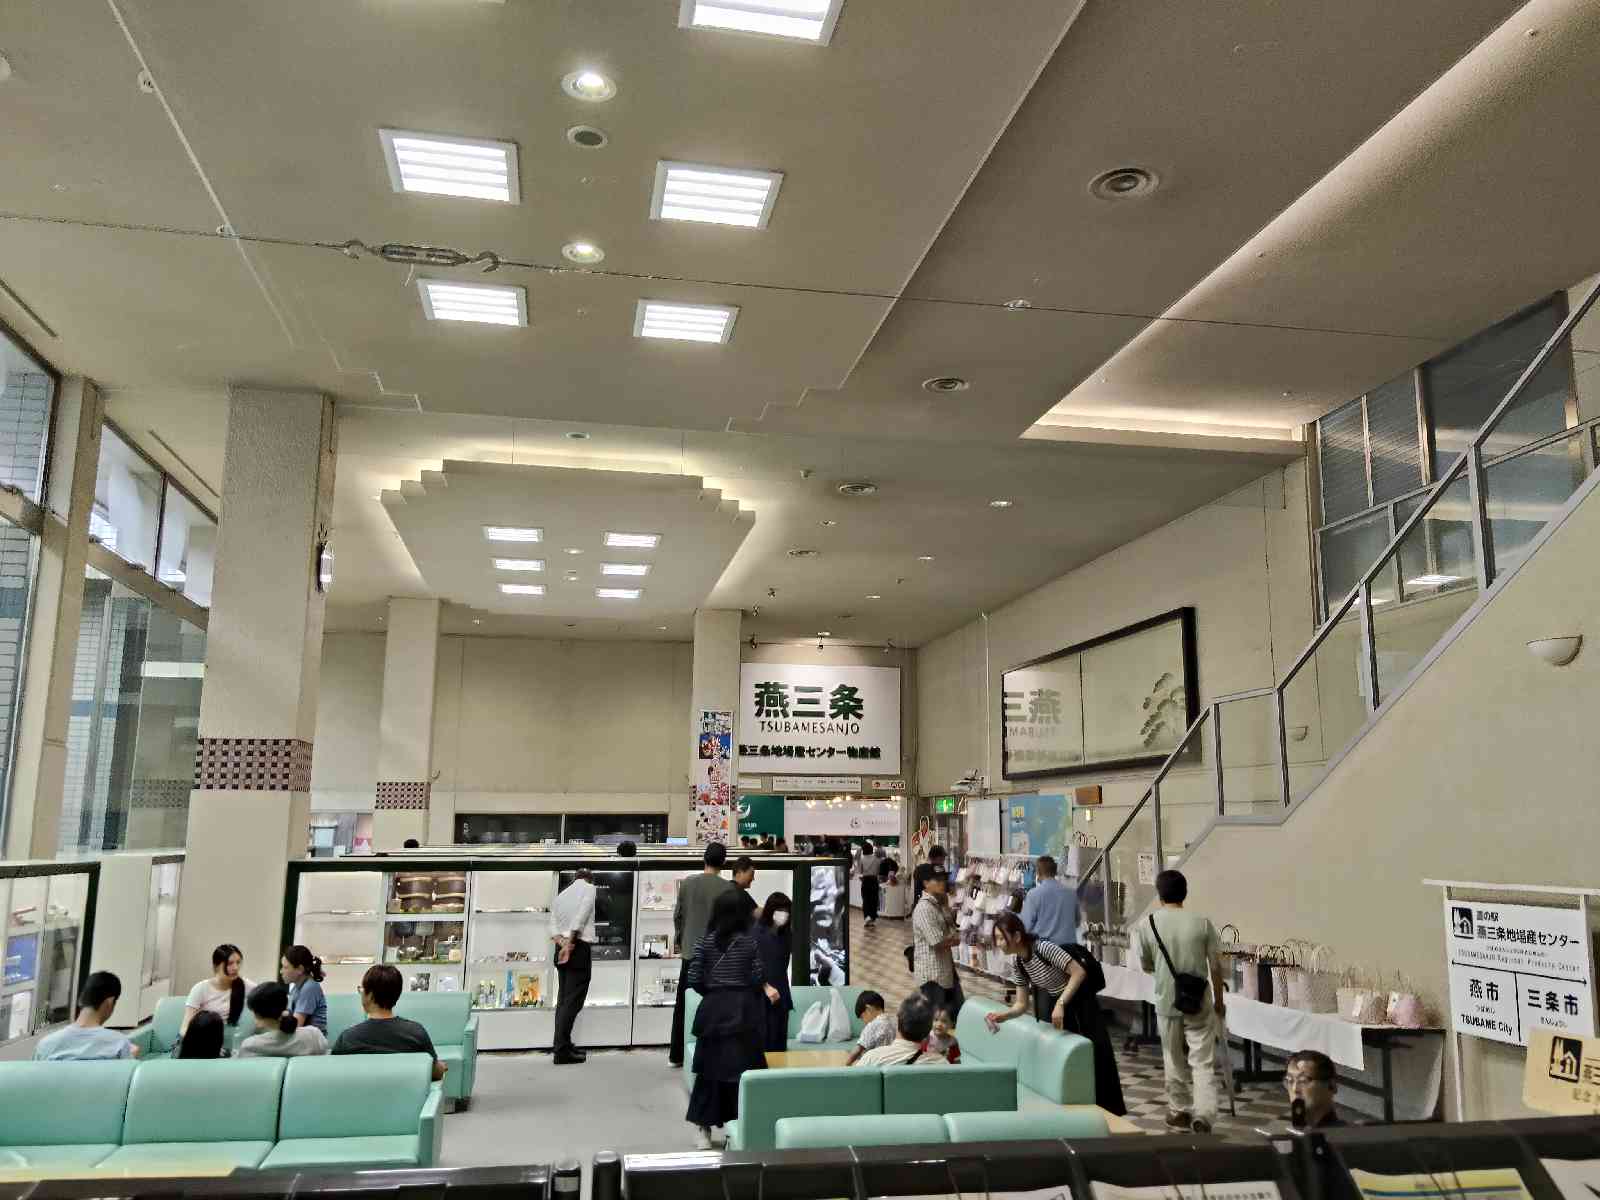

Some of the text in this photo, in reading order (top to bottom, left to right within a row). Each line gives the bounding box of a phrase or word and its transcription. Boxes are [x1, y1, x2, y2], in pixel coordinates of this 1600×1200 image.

[754, 681, 864, 720] 燕三条
[760, 720, 860, 735] TSUBAMESANJO
[1476, 910, 1499, 922] 道の駅
[1476, 925, 1580, 948] 燕三条地場産センター
[1469, 978, 1500, 1001] 燕市
[1527, 988, 1579, 1016] 三条市
[1461, 1014, 1513, 1036] TSUBAME City
